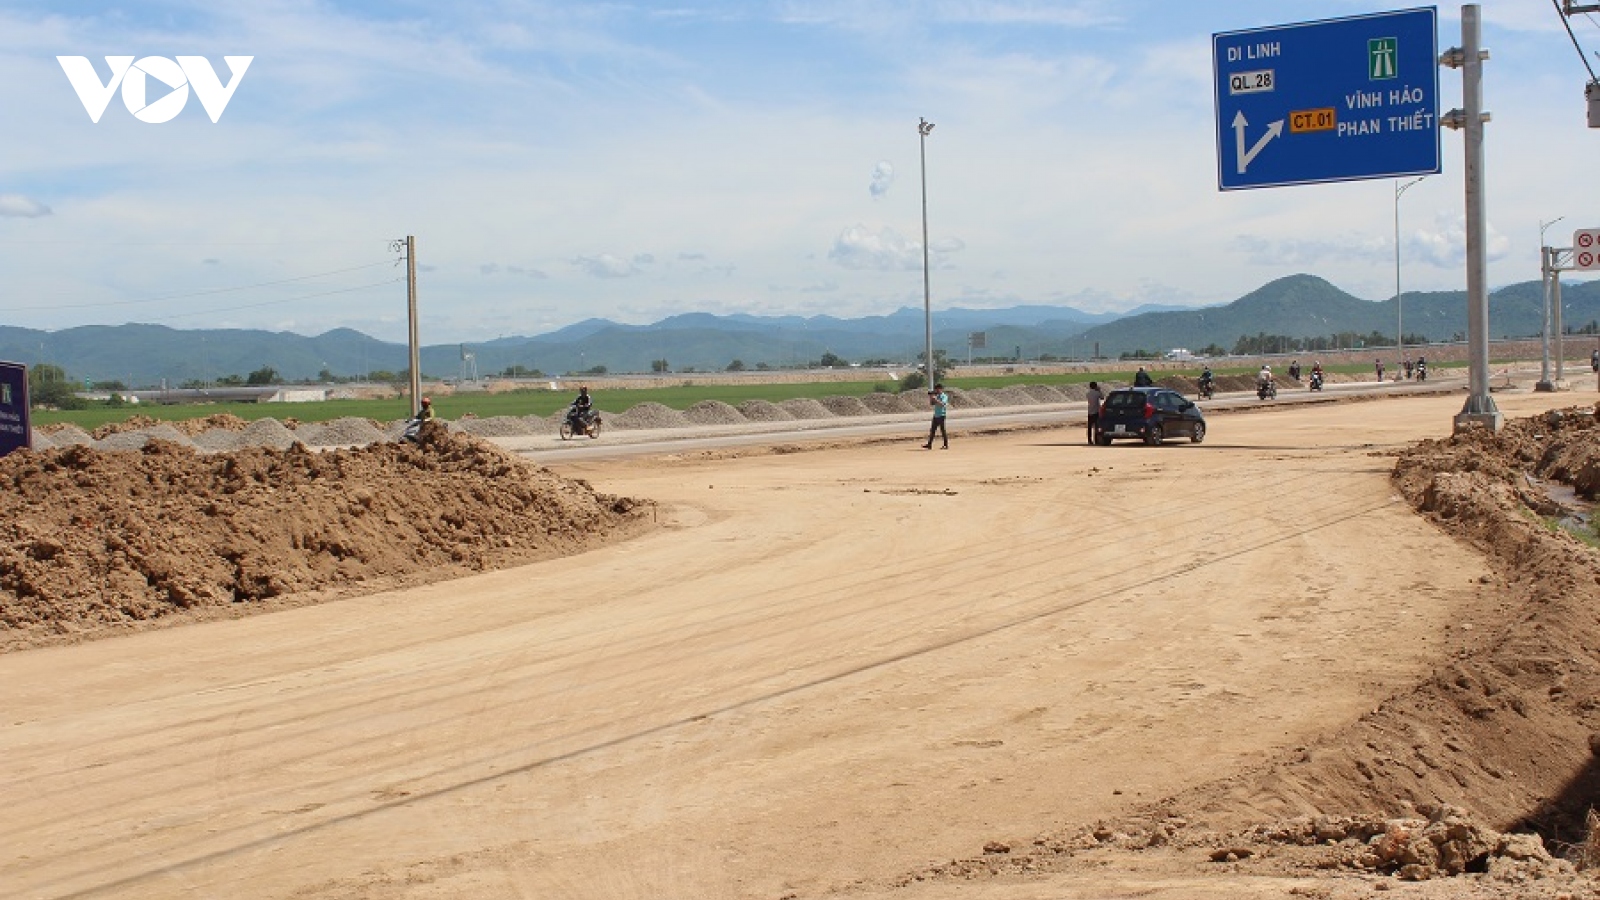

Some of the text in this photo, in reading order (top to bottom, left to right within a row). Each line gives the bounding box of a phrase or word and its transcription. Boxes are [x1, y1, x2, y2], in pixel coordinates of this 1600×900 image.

[1227, 41, 1281, 62] DI LINH
[1231, 73, 1272, 91] QL.28
[1345, 85, 1423, 109] VĨNH HẢO
[1293, 112, 1332, 129] CT.01
[1337, 107, 1434, 137] PHAN THIẾT
